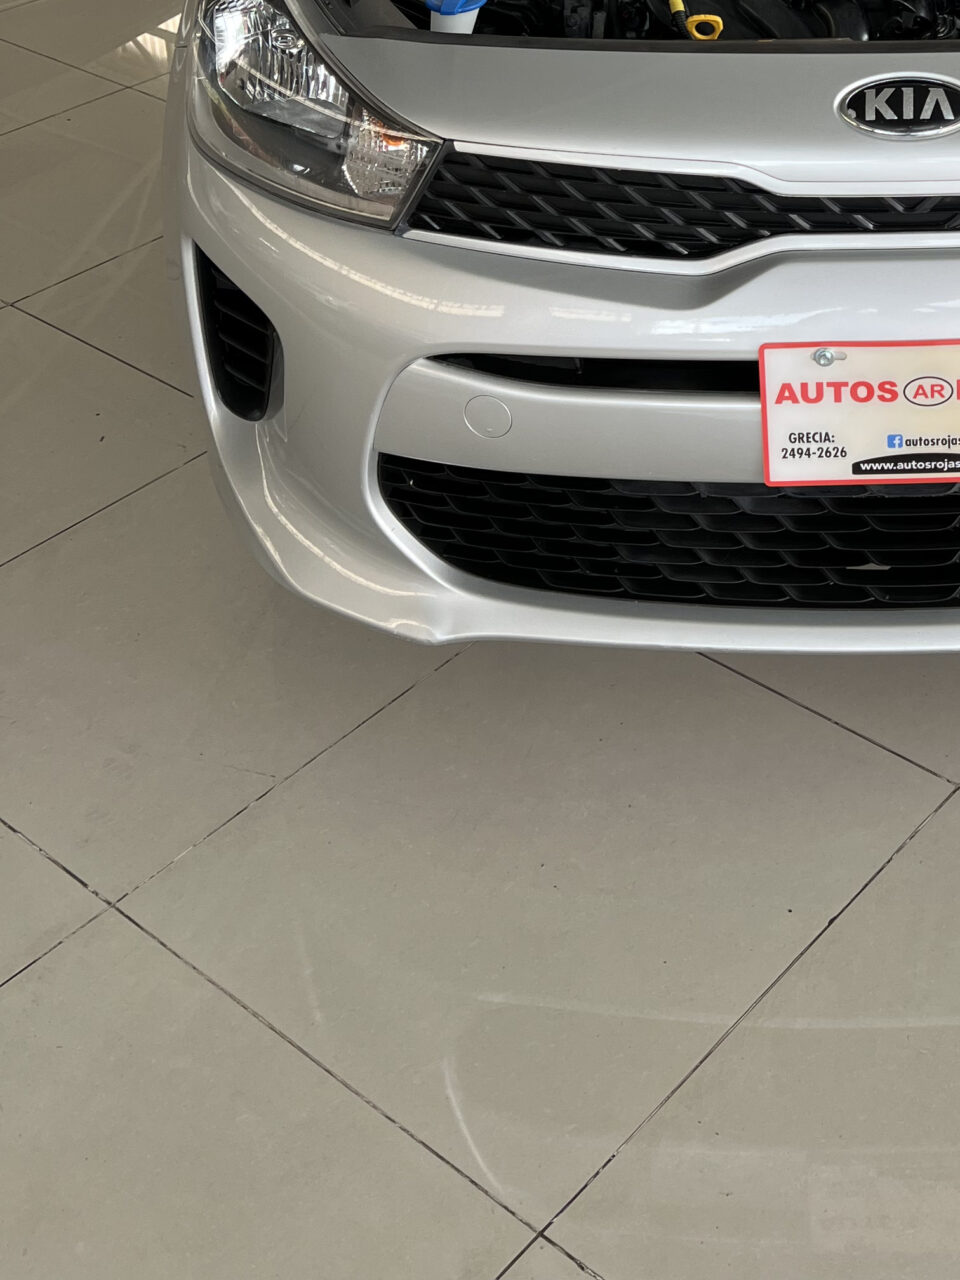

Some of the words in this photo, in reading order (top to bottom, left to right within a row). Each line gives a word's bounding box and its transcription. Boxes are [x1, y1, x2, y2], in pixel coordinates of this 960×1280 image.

[864, 87, 955, 120] KIA
[774, 381, 899, 405] AUTOS
[912, 383, 946, 399] AR
[788, 431, 835, 444] GRECIA:
[781, 446, 847, 460] 2494-2626
